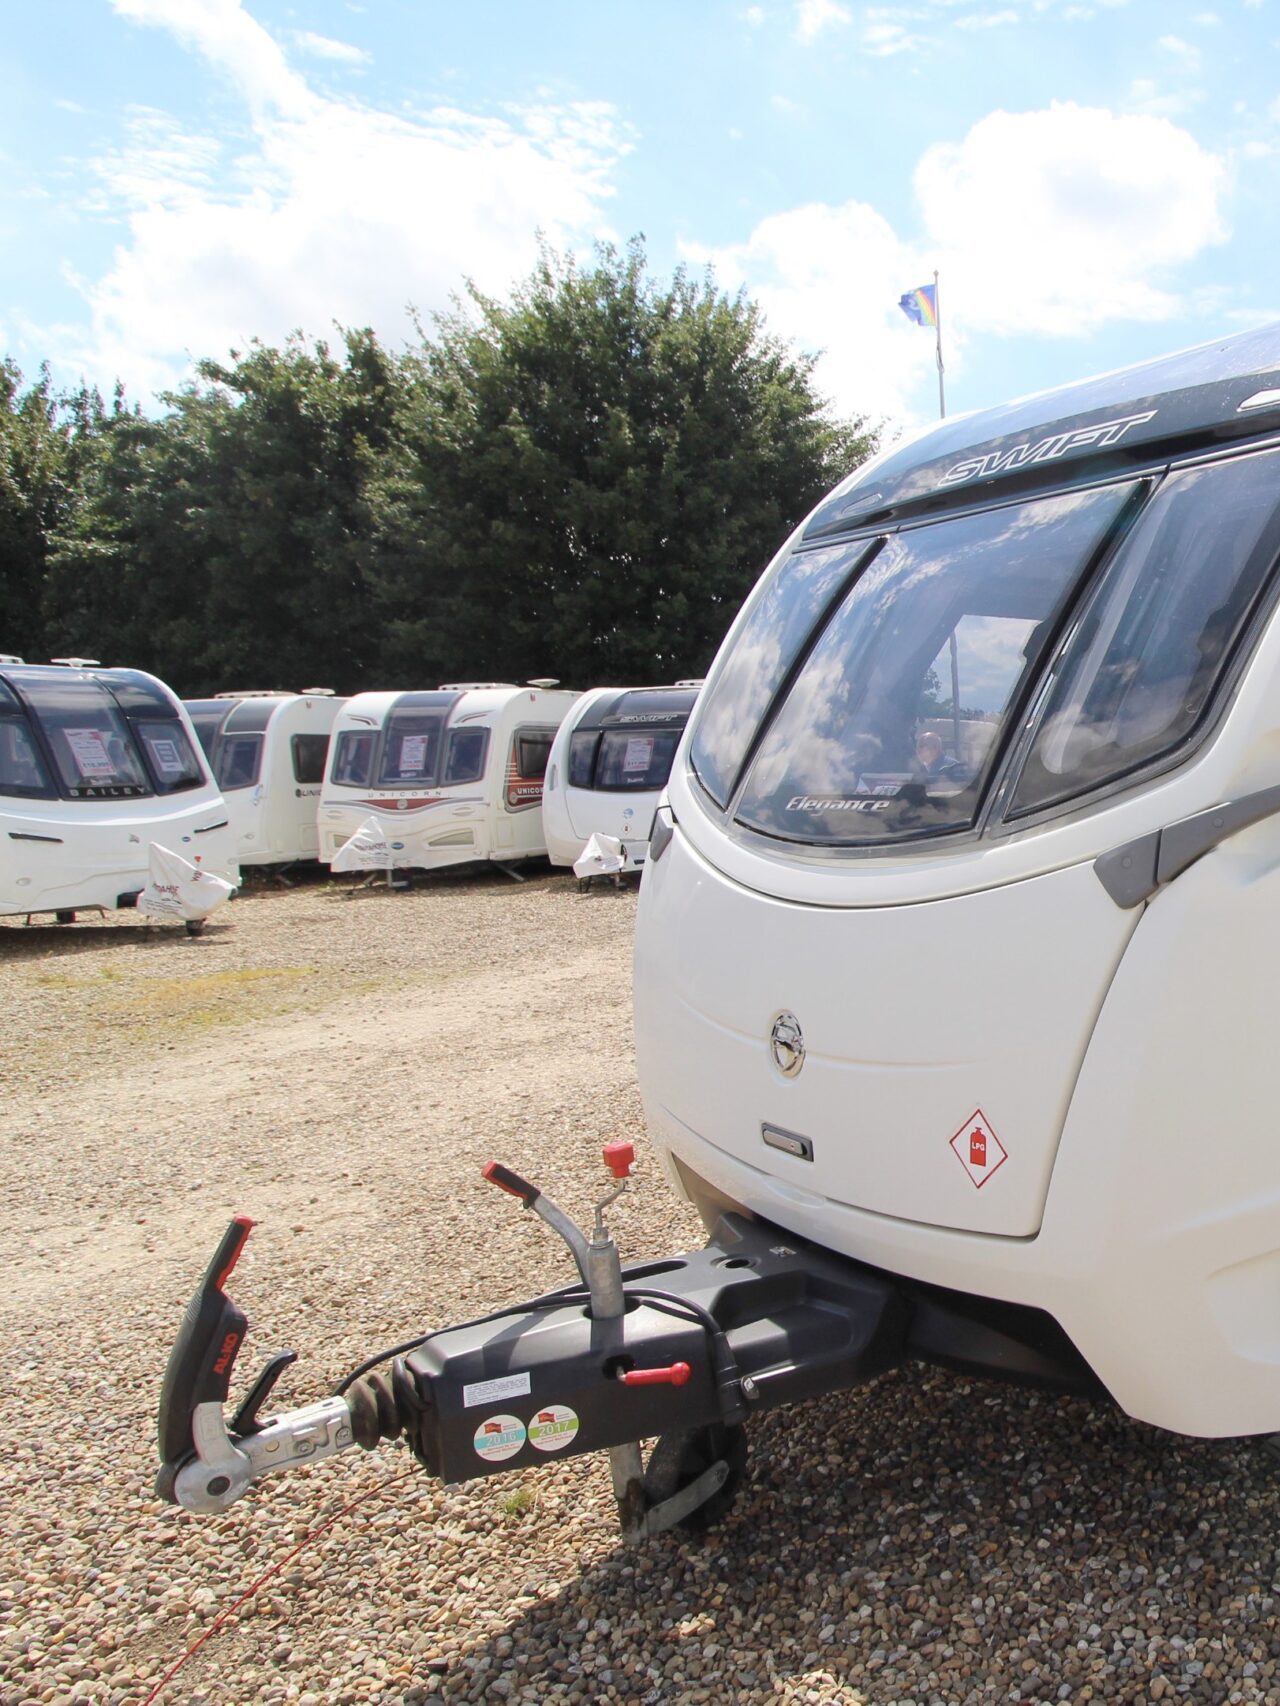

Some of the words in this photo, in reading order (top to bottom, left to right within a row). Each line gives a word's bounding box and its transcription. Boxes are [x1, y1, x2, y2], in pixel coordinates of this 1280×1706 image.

[937, 409, 1159, 487] SWIFT
[69, 788, 145, 797] BAILEY
[368, 790, 442, 799] UNICORN
[785, 795, 890, 816] Elegance
[971, 1141, 985, 1151] LPG
[212, 1332, 239, 1374] AL-KO
[538, 1421, 570, 1437] 2017
[486, 1431, 517, 1447] 2016
